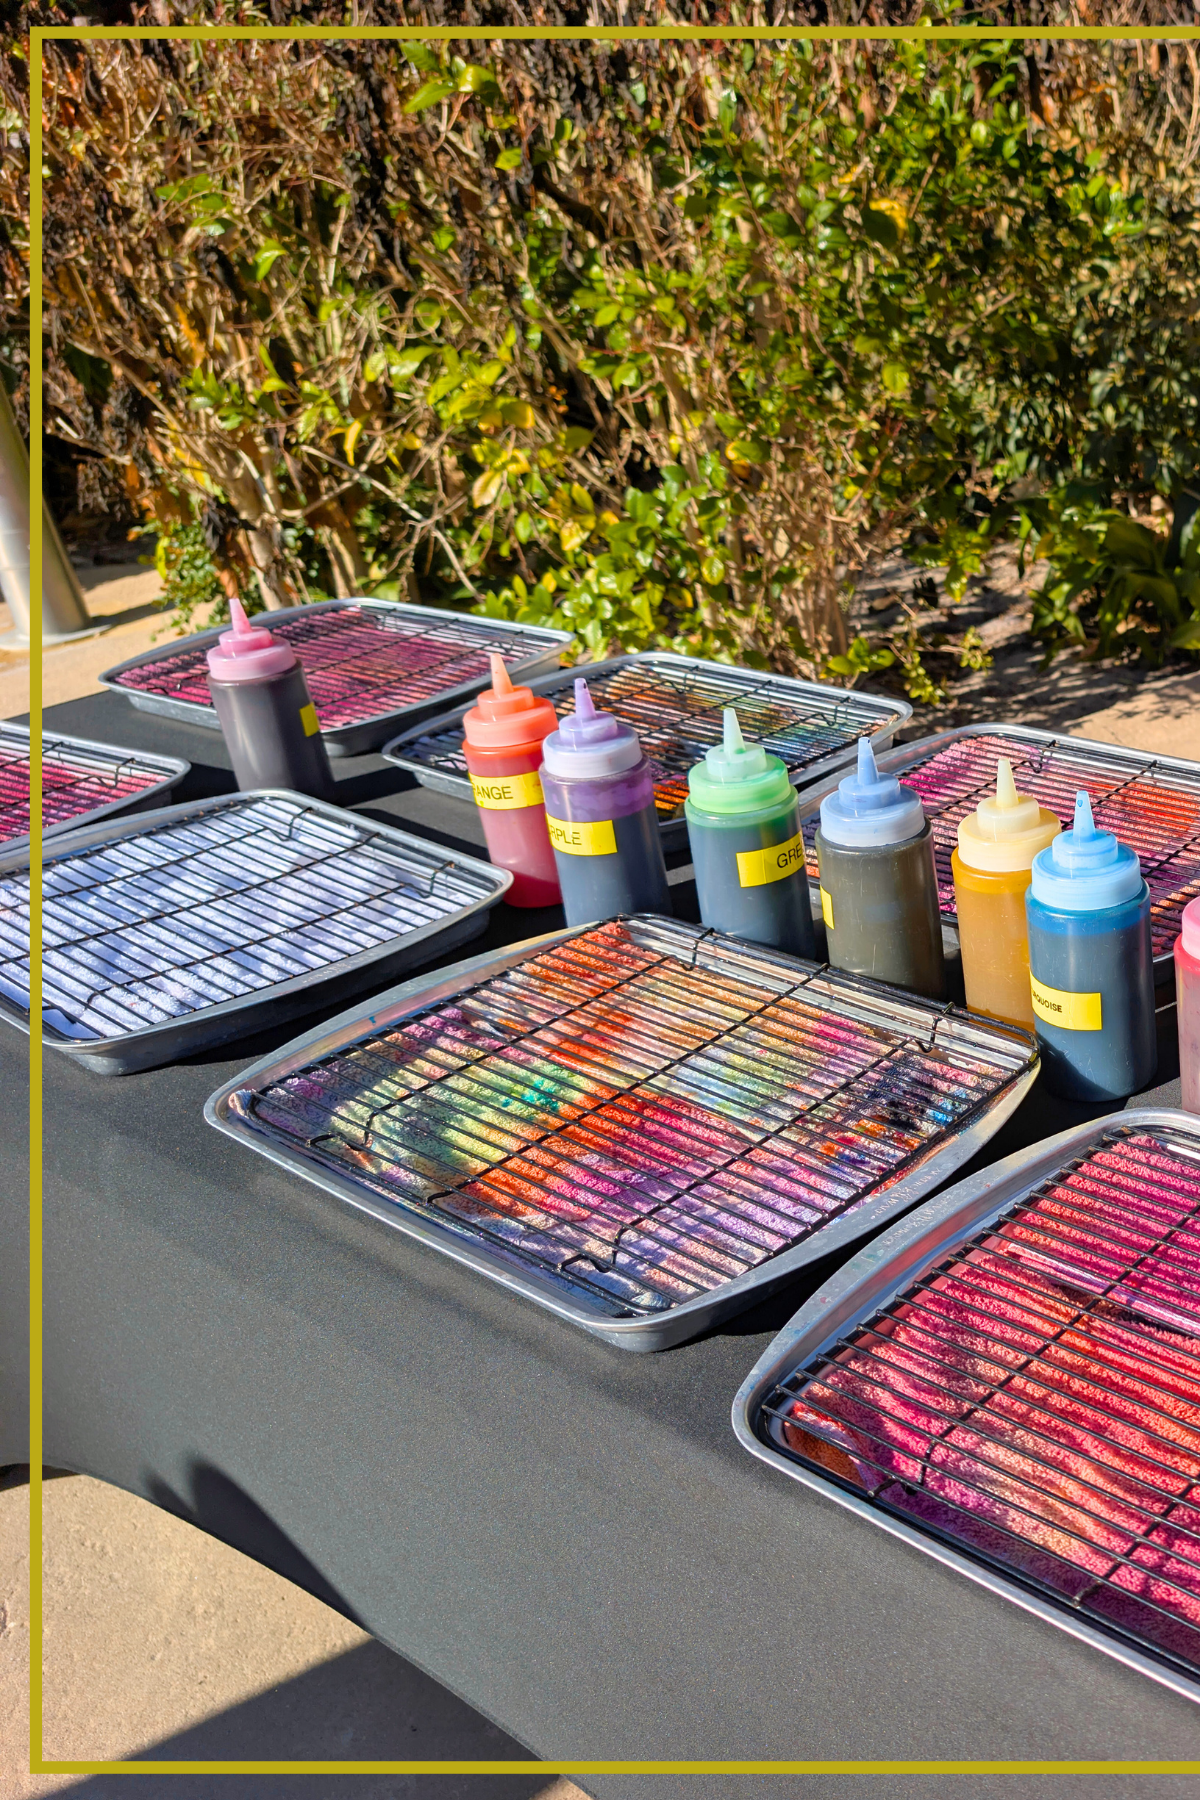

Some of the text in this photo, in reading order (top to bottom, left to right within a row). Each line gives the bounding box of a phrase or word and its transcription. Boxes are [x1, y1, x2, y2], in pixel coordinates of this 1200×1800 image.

[473, 785, 514, 800] ANGE
[549, 824, 582, 845] RPLE
[776, 842, 803, 869] GRE
[1031, 988, 1063, 1014] RQUOISE
